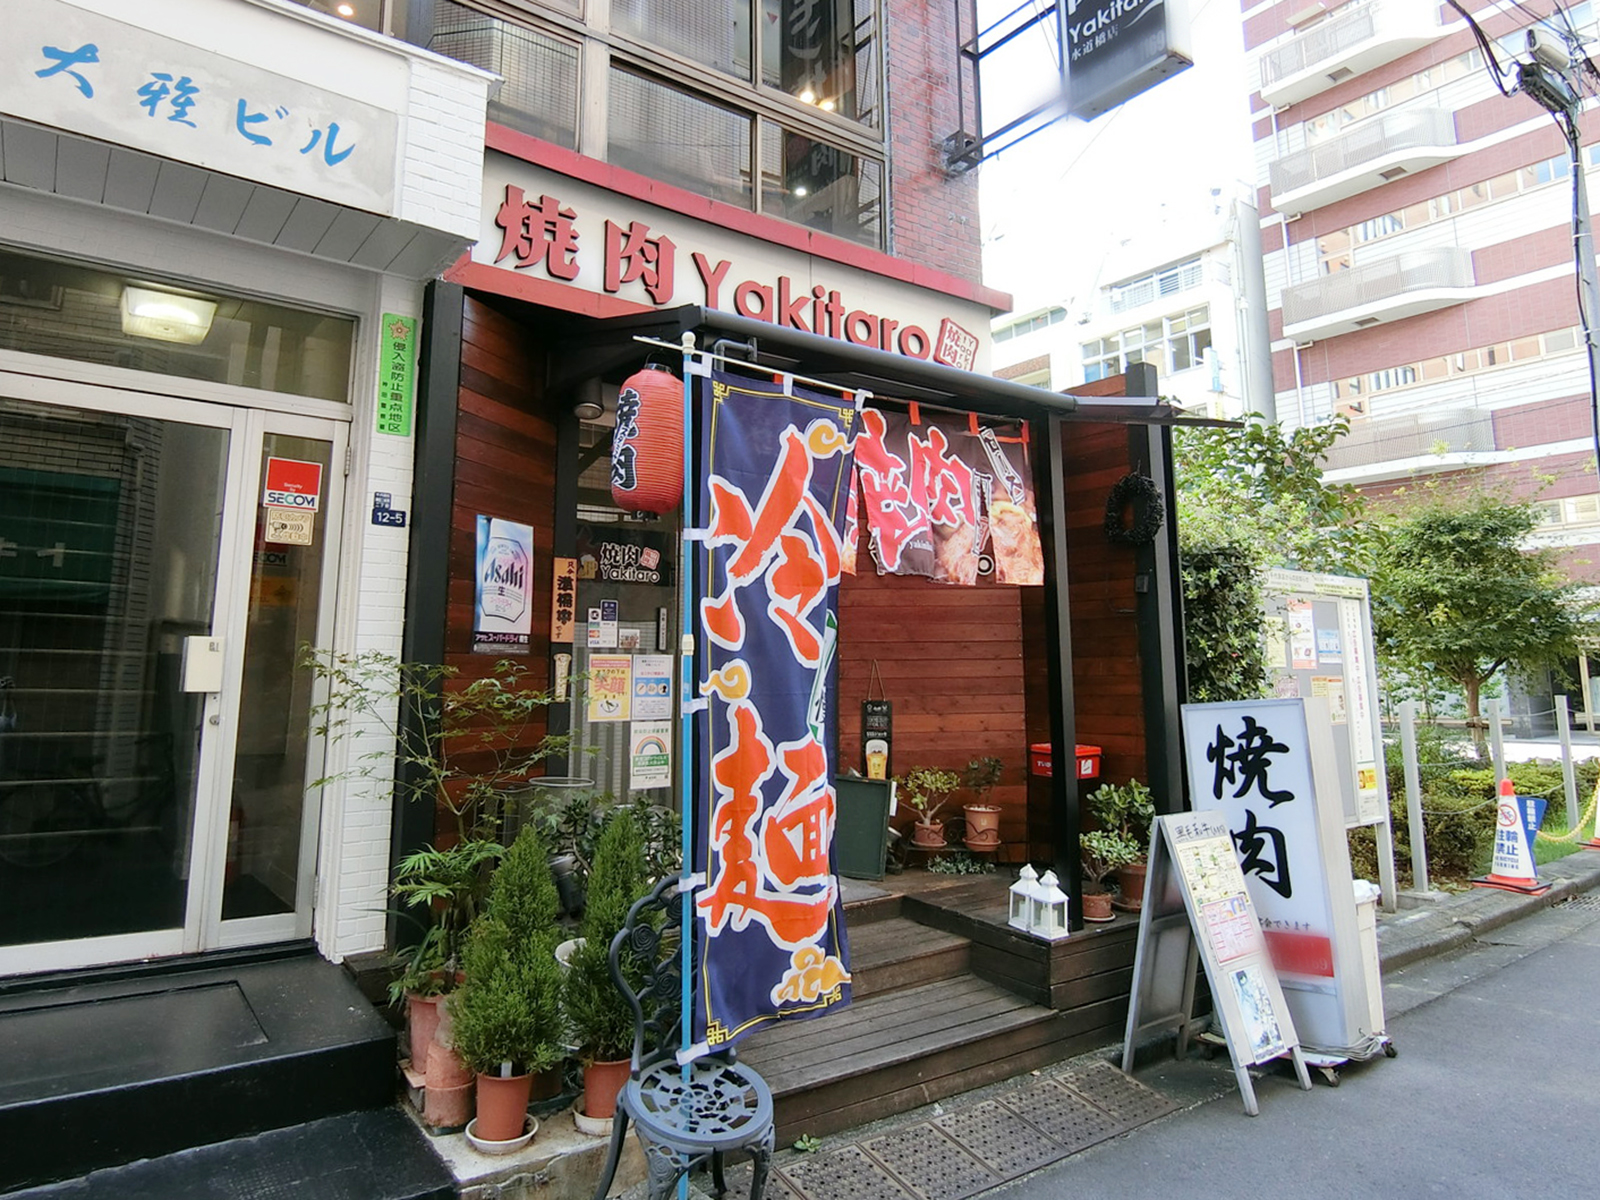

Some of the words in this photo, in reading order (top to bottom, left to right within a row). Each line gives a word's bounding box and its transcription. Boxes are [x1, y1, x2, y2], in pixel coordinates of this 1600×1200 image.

[1071, 24, 1119, 61] 水道橋店
[35, 42, 356, 168] 大雅ビル
[494, 184, 677, 306] 焼肉
[691, 252, 932, 363] Yakitaro
[388, 341, 407, 433] 侵入盗防止重点地区
[267, 491, 315, 507] SECOM
[377, 511, 403, 524] 12-5
[600, 542, 641, 566] 焼肉
[484, 557, 524, 590] Asahi
[601, 564, 661, 584] Yakitaro
[1206, 716, 1296, 900] 焼肉
[1495, 842, 1519, 857] 禁止
